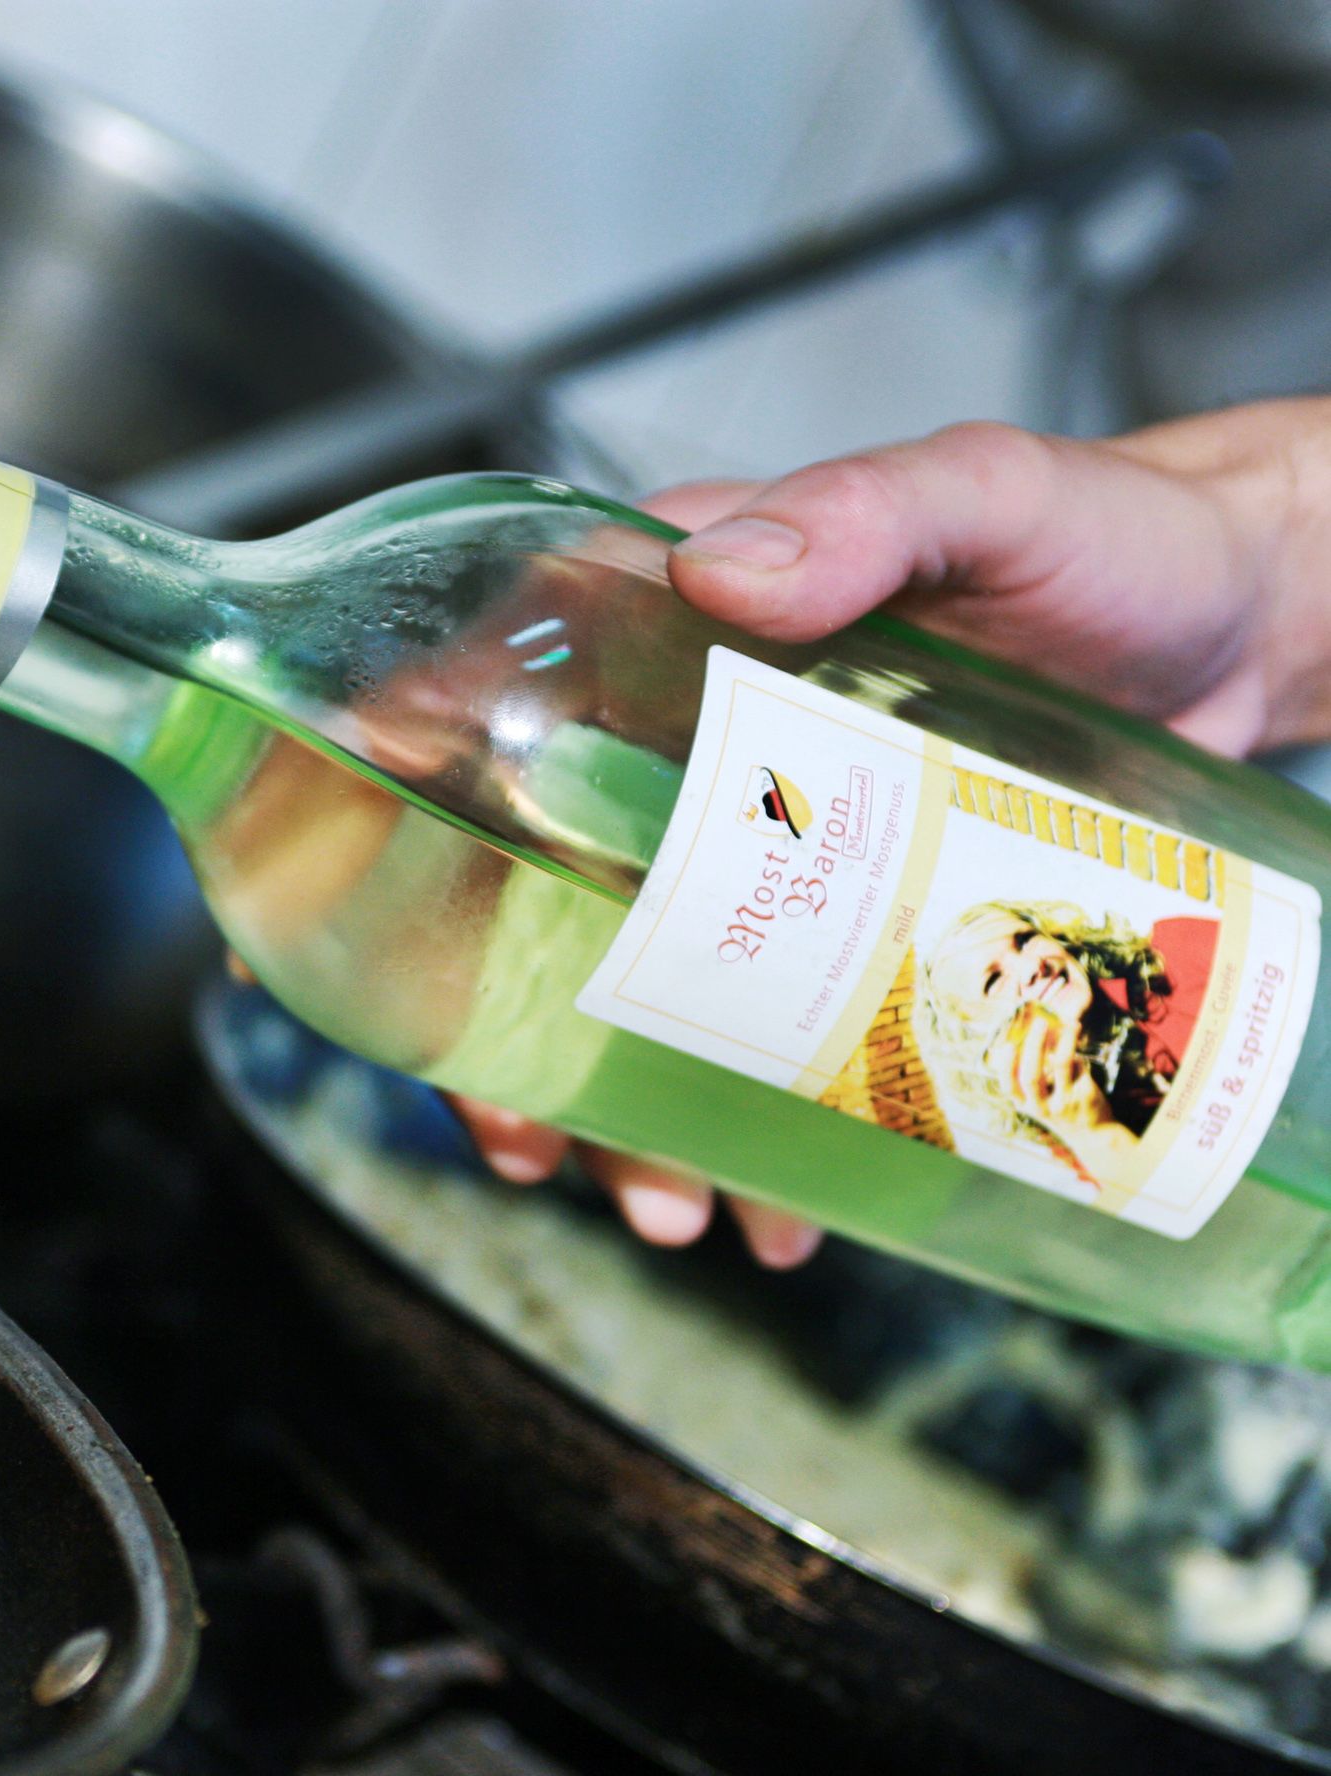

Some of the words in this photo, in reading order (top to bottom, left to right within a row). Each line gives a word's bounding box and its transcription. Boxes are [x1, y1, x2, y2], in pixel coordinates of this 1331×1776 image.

[718, 850, 789, 963] Most
[781, 795, 851, 919] Baron
[797, 984, 835, 1033] Echter
[827, 885, 879, 983] Mostviertler
[893, 904, 915, 945] mild
[1221, 1076, 1246, 1096] &
[1238, 963, 1285, 1069] spritzig
